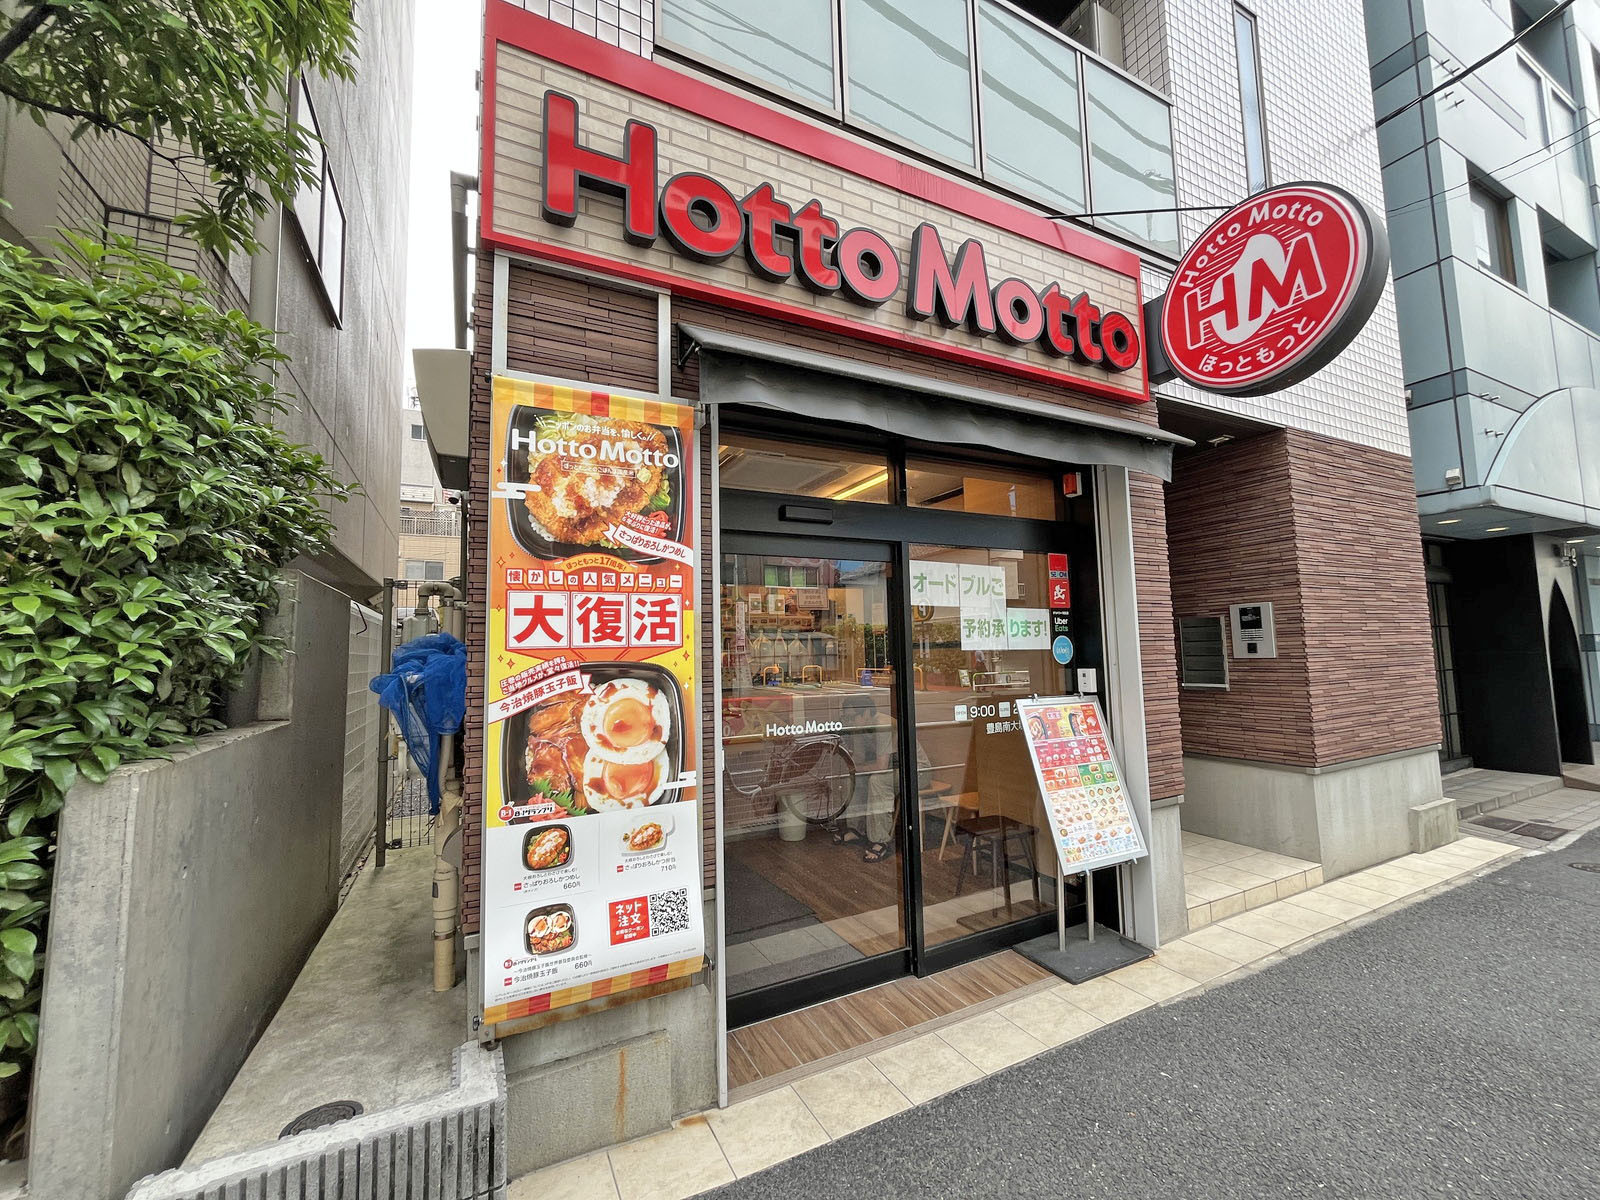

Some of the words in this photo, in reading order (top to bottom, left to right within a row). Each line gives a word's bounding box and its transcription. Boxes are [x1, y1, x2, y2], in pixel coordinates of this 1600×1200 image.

[542, 90, 900, 307] Hotto
[906, 222, 1140, 373] Motto
[1180, 223, 1241, 288] Hotto
[1248, 202, 1323, 227] Motto
[1198, 317, 1316, 374] ほっともっと
[511, 428, 597, 459] Hotto
[600, 440, 680, 468] Motto
[619, 530, 686, 558] さっぱりおろしかつめし
[566, 556, 627, 571] ほっともっと17周年!
[508, 570, 681, 586] 懐かしの人気メニュー
[913, 573, 1004, 596] オードブルご
[513, 595, 678, 644] 大復活
[963, 618, 1047, 639] 予約承ります!
[500, 675, 577, 712] 今治焼豚玉子飯
[970, 705, 995, 718] 9:00
[766, 724, 804, 737] Hotto
[806, 720, 843, 734] Motto
[616, 901, 642, 915] ネット
[618, 913, 641, 927] 注文
